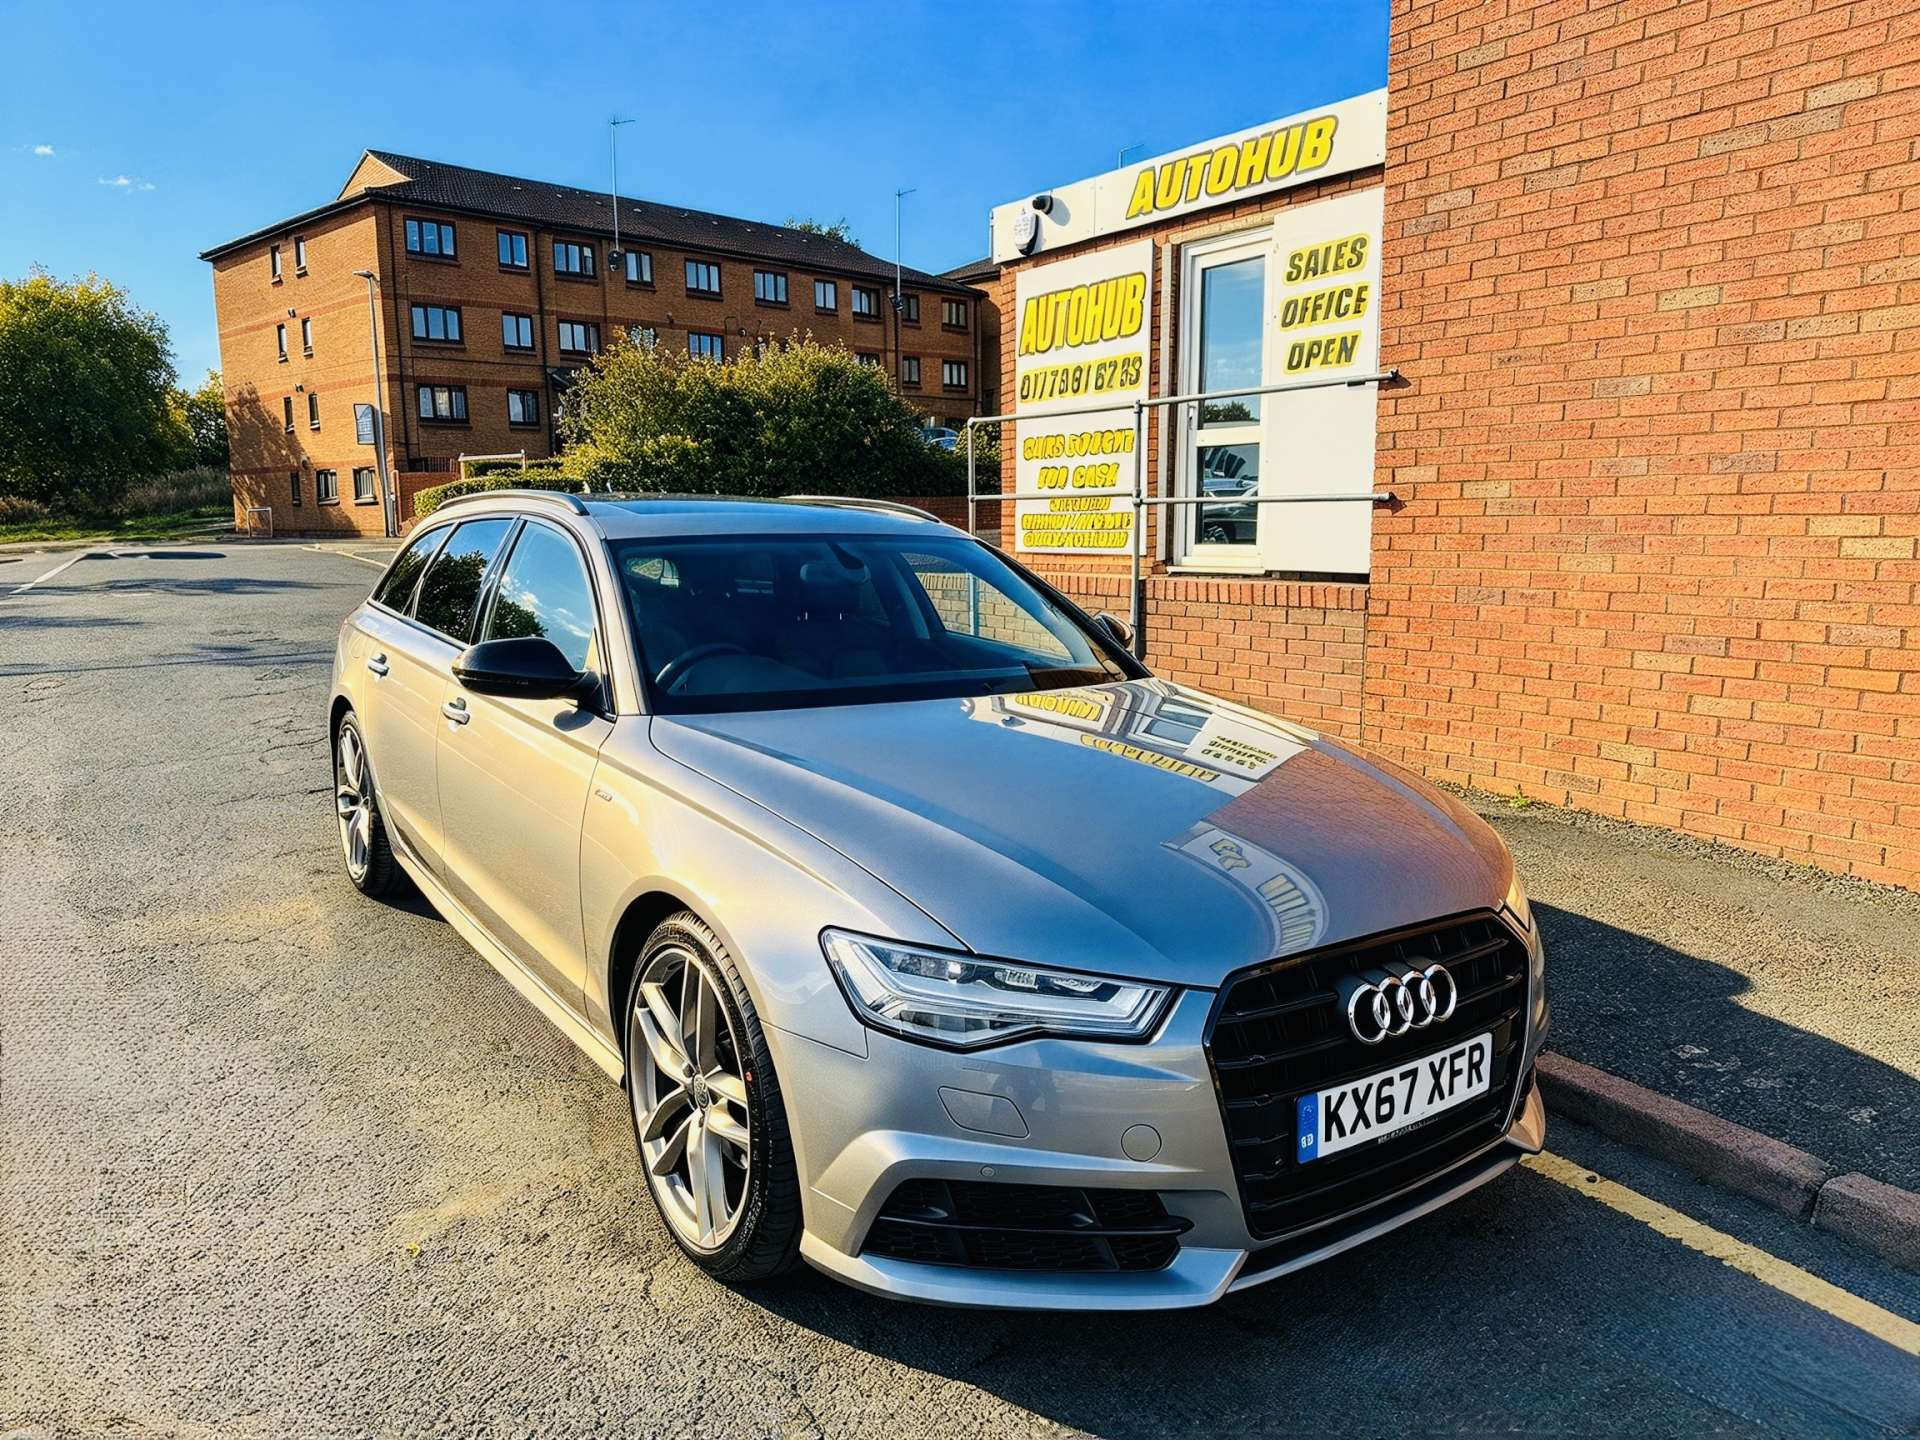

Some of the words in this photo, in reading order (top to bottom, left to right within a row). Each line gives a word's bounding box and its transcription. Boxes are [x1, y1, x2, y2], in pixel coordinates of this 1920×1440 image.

[1126, 115, 1338, 219] AUTOHUB
[1286, 237, 1367, 281] SALES
[1019, 272, 1146, 357] AUTOHUB
[1281, 285, 1368, 328] OFFICE
[1287, 335, 1359, 370] OPEN
[1324, 1066, 1419, 1142] KX67
[1427, 1042, 1485, 1105] XFR
